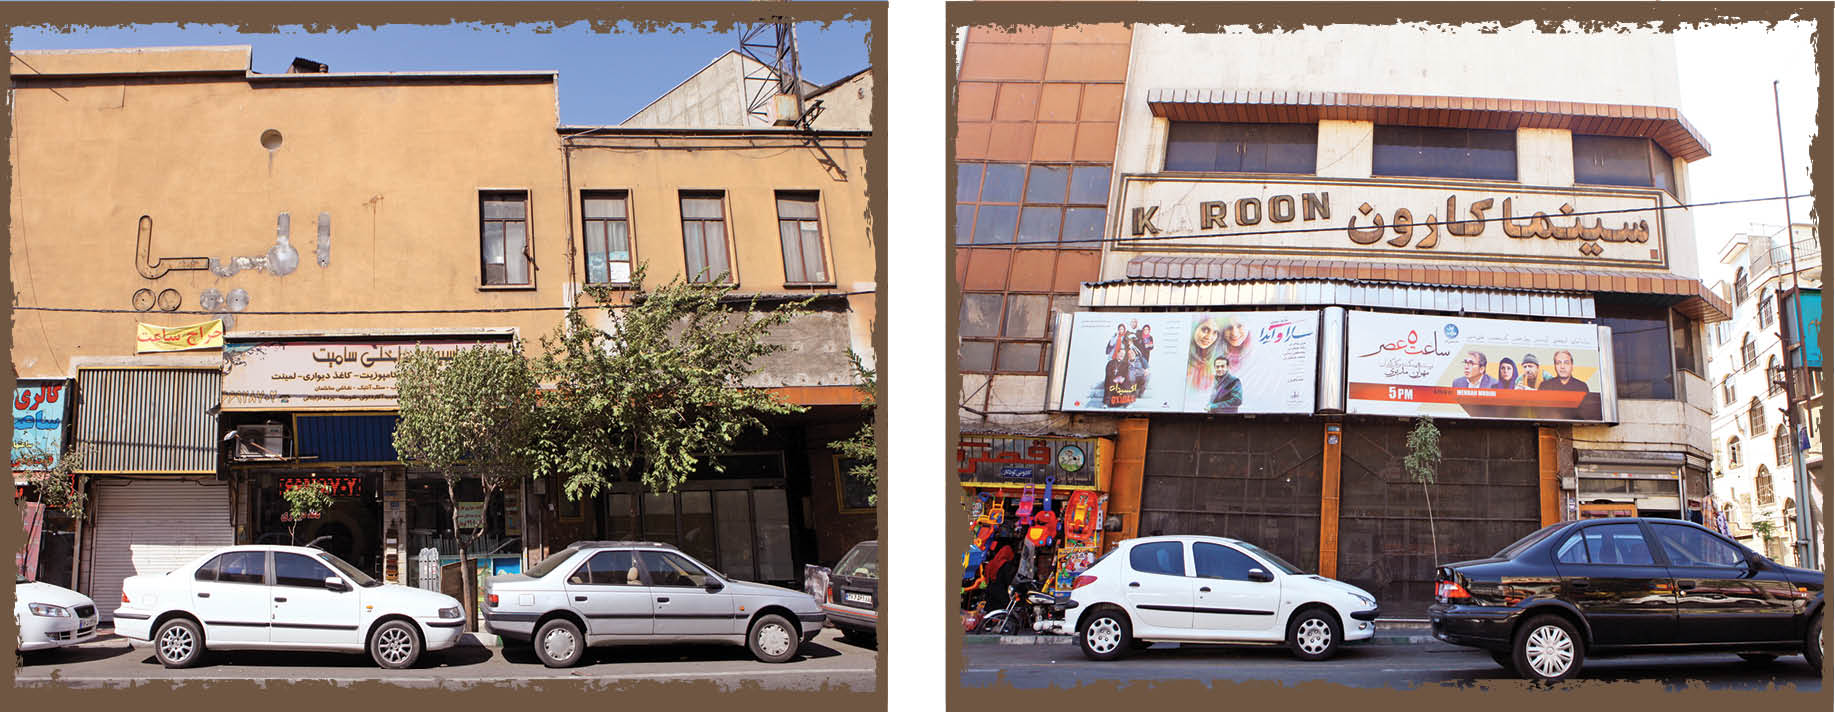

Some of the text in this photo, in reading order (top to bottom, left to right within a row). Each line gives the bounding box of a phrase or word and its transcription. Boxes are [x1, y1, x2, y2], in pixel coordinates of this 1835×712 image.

[1132, 192, 1331, 236] KROON
[1347, 194, 1650, 256] سینما کارون
[137, 326, 222, 346] حراج ساعت
[1284, 326, 1313, 343] سارا
[1404, 330, 1450, 356] ساعت
[1407, 329, 1418, 345] ۵
[312, 346, 358, 368] سامیت
[1358, 339, 1408, 357] عصر
[1389, 386, 1414, 401] 5 PM
